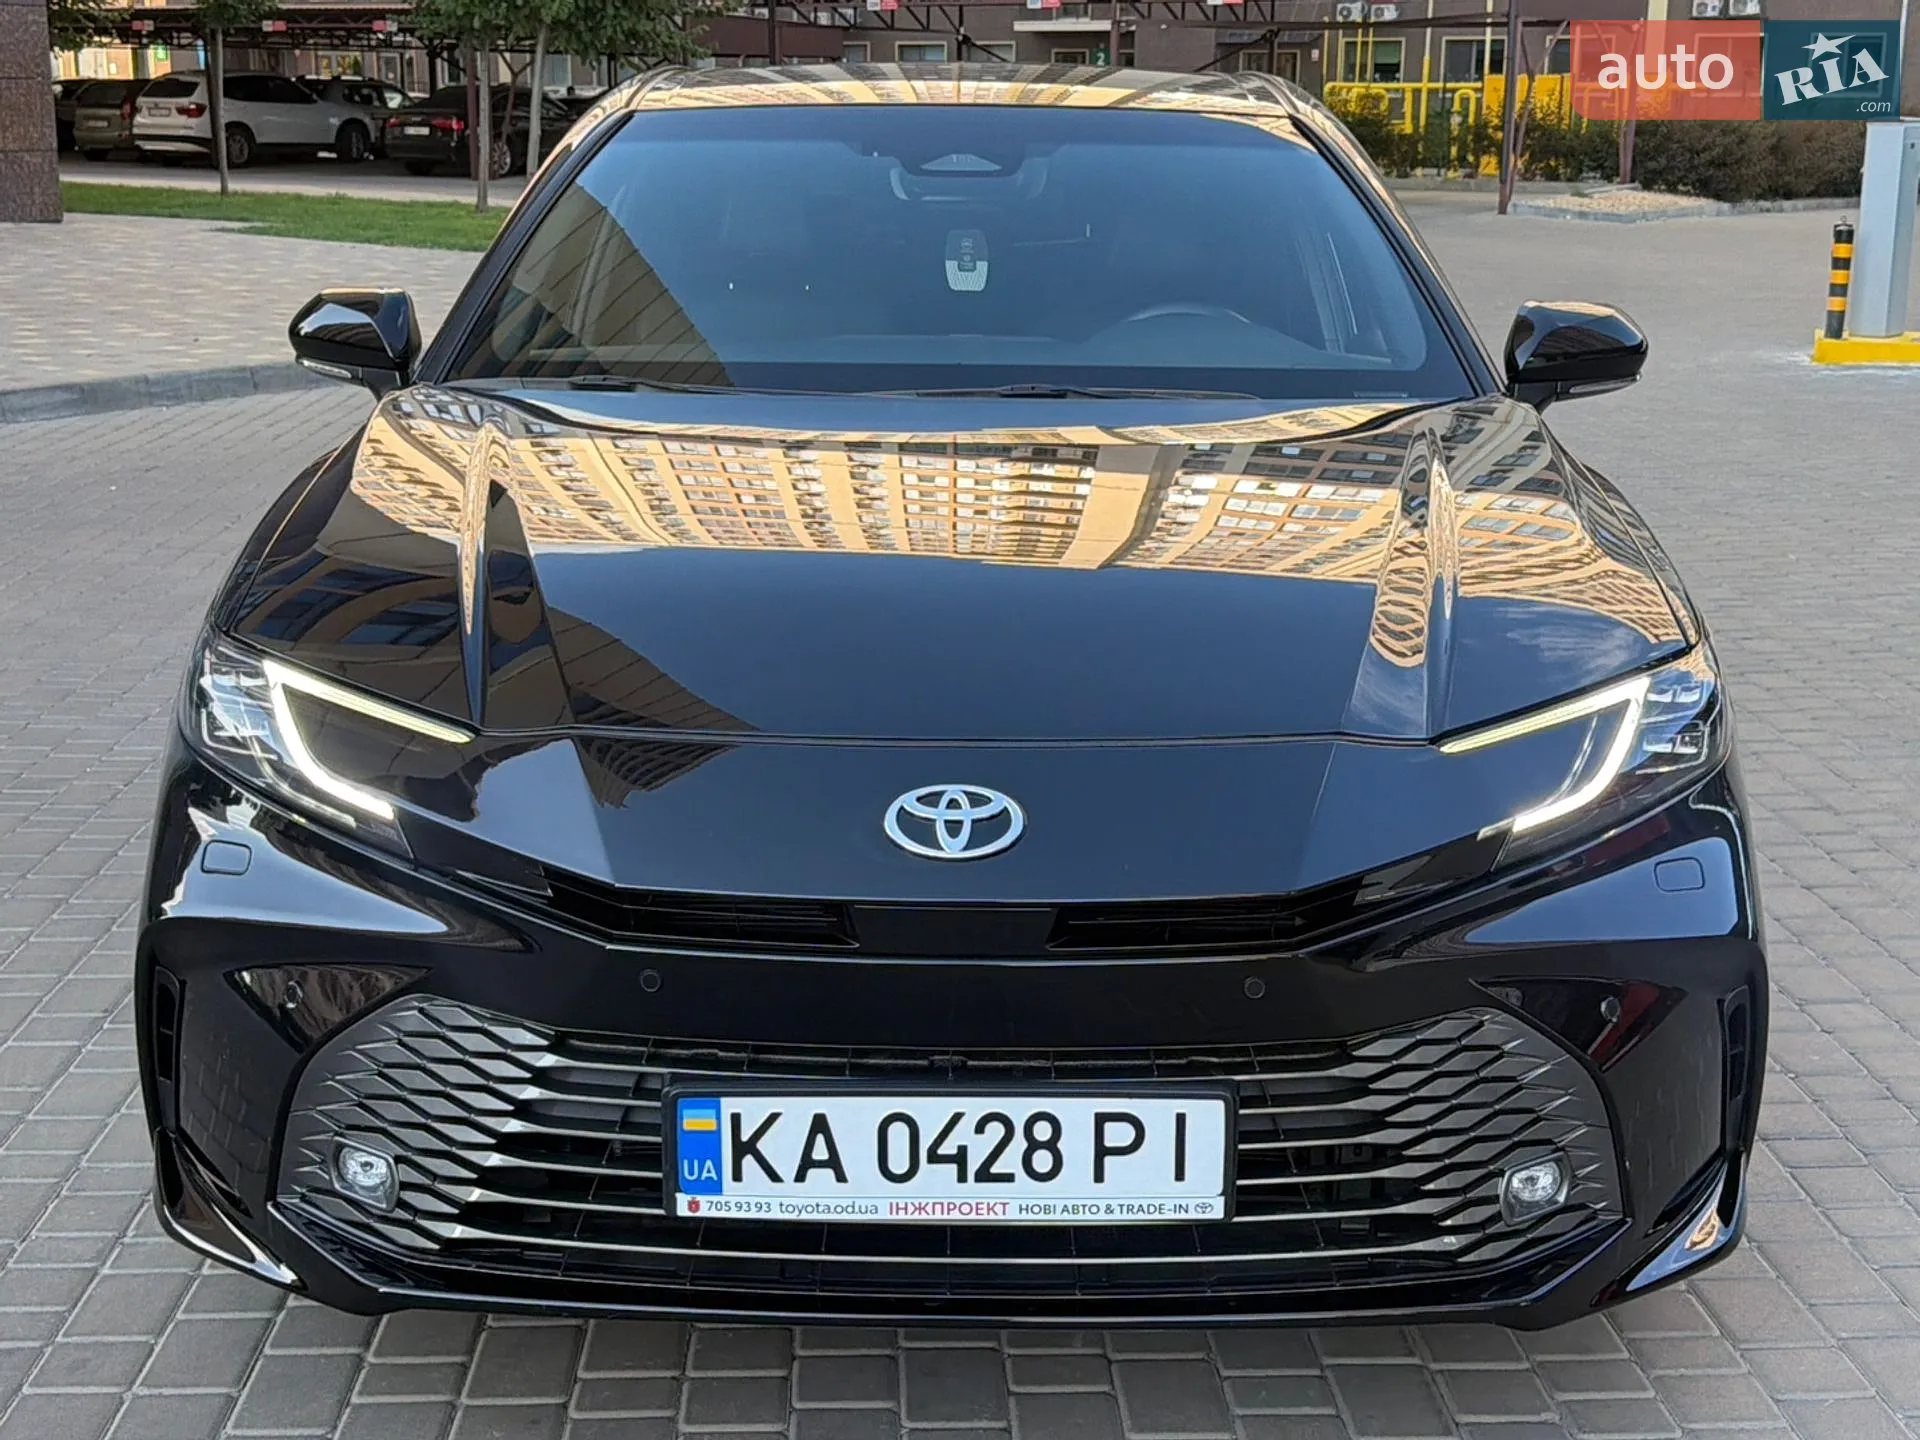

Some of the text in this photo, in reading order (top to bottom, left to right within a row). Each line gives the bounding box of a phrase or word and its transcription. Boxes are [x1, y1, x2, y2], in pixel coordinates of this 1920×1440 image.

[1096, 52, 1105, 66] 2
[729, 1111, 849, 1184] KA
[876, 1110, 1064, 1184] 0428
[682, 1158, 718, 1181] UA
[705, 1199, 732, 1213] 705
[735, 1200, 751, 1213] 93
[755, 1200, 772, 1213] 93
[778, 1200, 879, 1217] toyota.od.ua
[888, 1201, 1010, 1216] ІНЖПРОЕКТ
[1103, 1203, 1115, 1215] &
[1118, 1203, 1189, 1215] TRADE-IN
